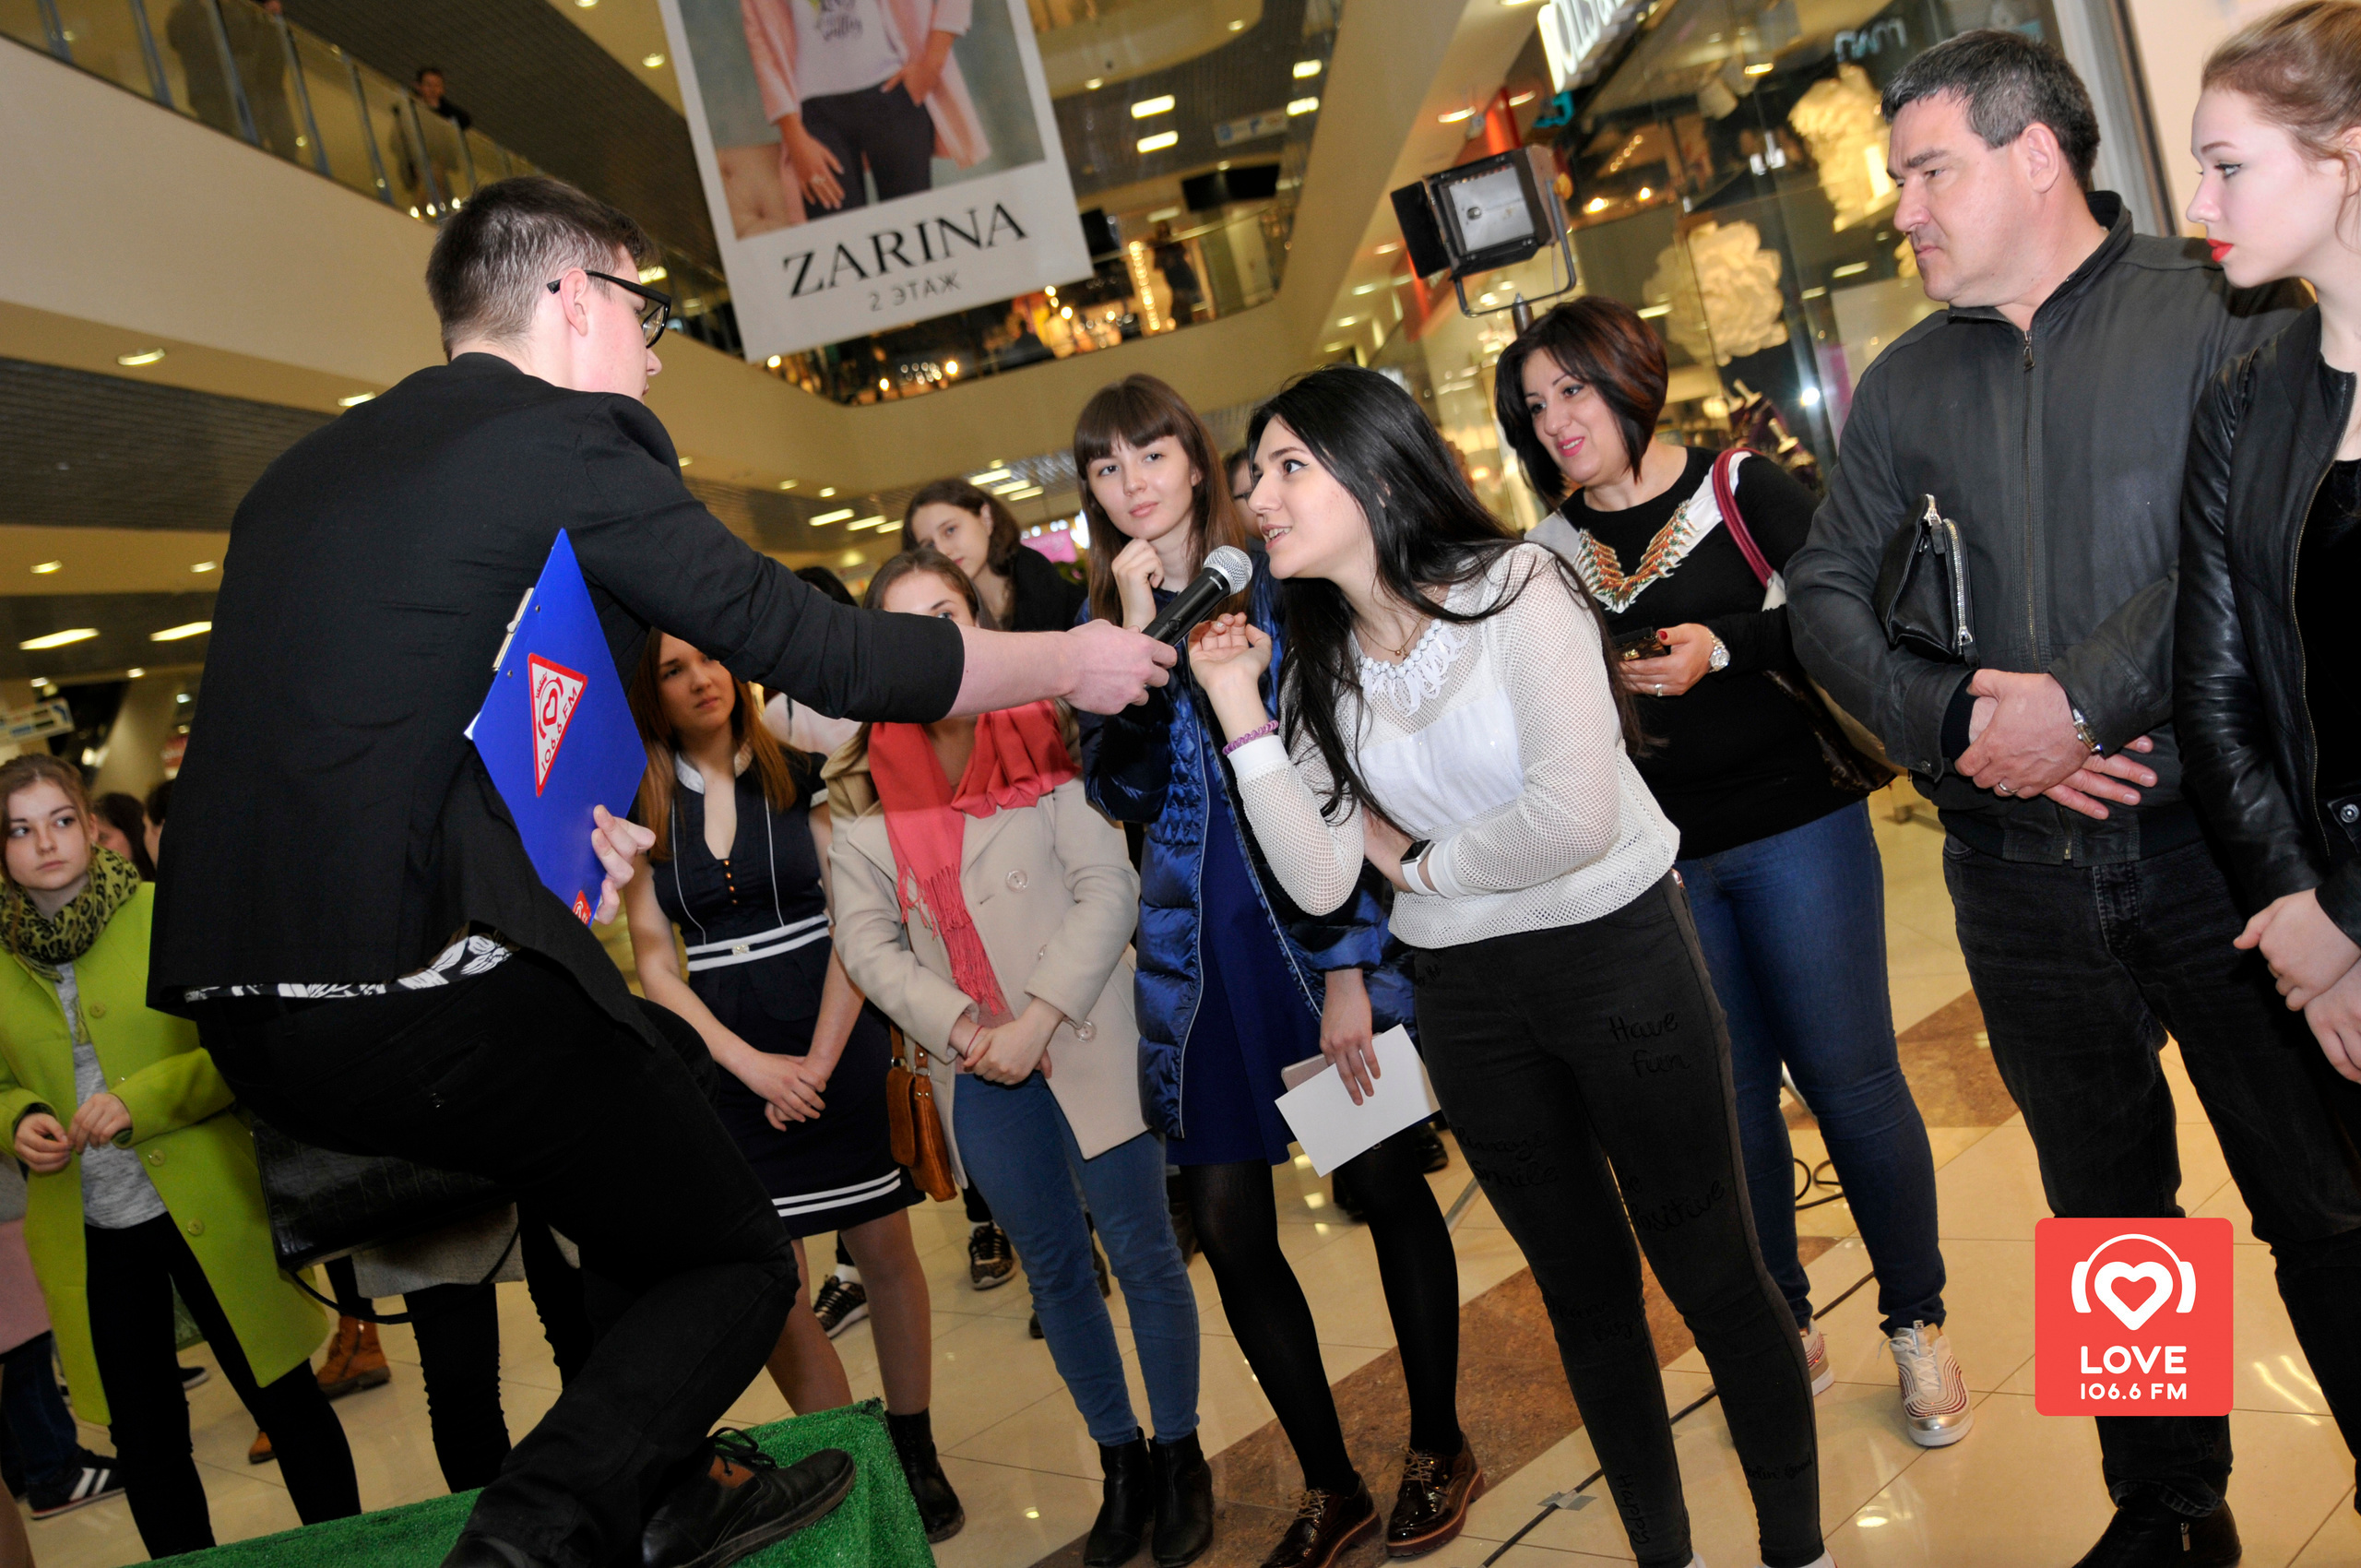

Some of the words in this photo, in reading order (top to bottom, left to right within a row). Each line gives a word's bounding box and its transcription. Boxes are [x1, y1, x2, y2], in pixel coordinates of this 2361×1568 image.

[782, 202, 1028, 298] ZARINA
[870, 291, 883, 312] 2
[890, 271, 961, 307] ЭТАЖ
[563, 686, 578, 719] FM
[1608, 1012, 1679, 1042] Have
[1616, 1473, 1650, 1544] Happy
